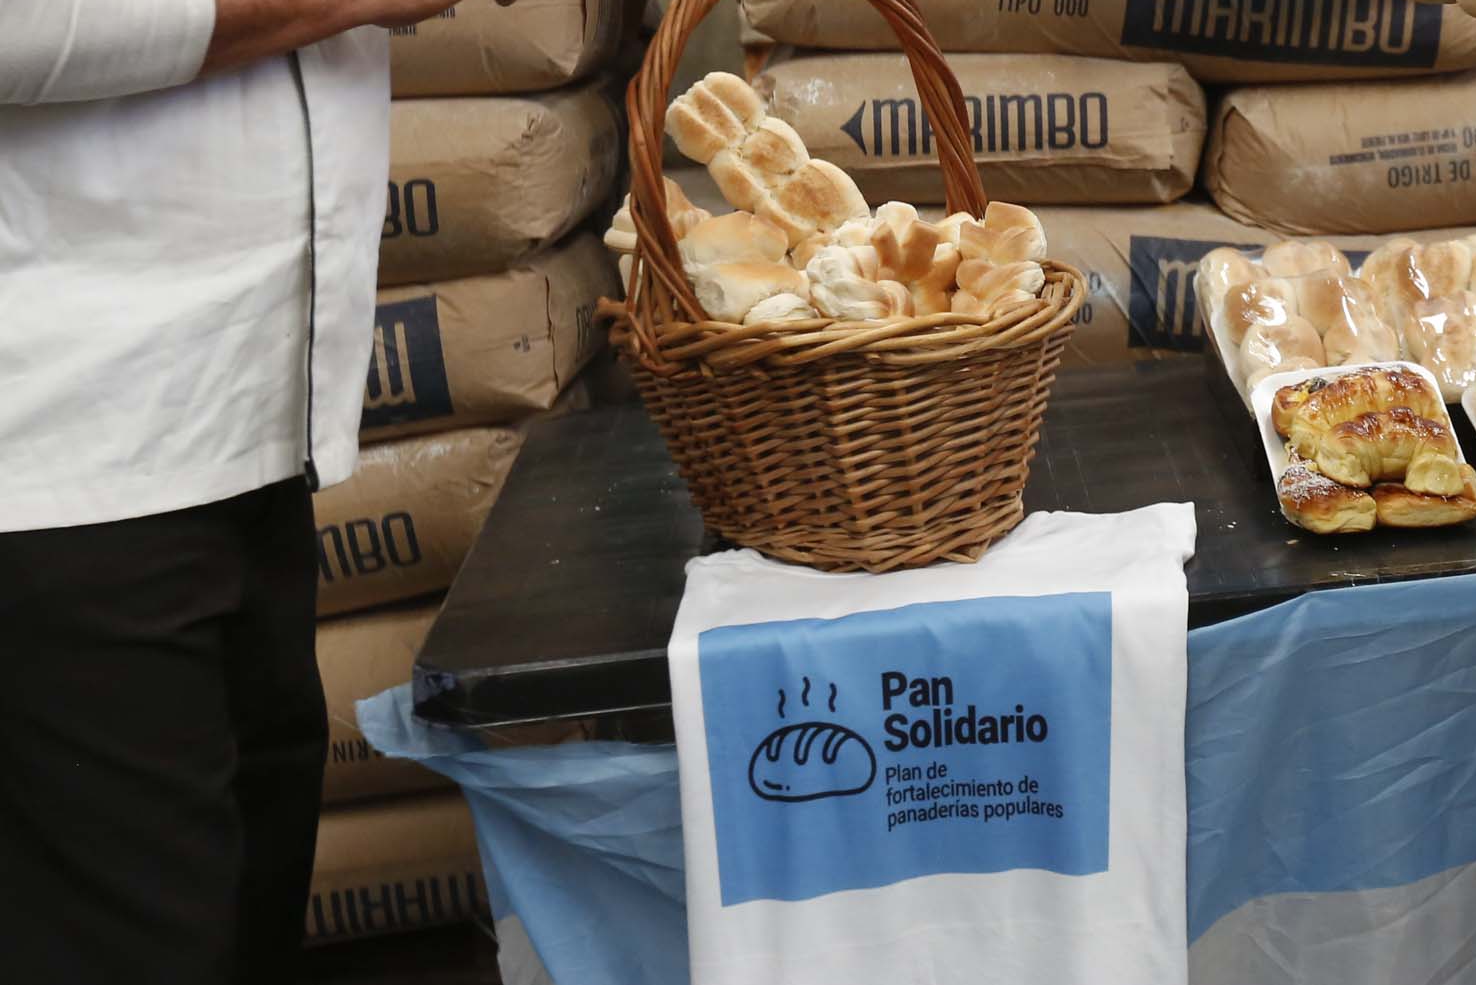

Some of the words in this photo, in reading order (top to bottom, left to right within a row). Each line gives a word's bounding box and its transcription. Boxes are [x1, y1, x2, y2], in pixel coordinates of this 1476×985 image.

[1386, 161, 1442, 189] TRIGO
[1449, 160, 1471, 182] DE
[880, 671, 953, 710] Pan
[883, 704, 1048, 752] Solidario
[885, 763, 923, 785] Plan
[926, 761, 948, 781] de
[886, 779, 1014, 807] fortalecimiento
[1018, 775, 1040, 795] de
[887, 796, 980, 832] panaderías
[984, 795, 1065, 823] populares
